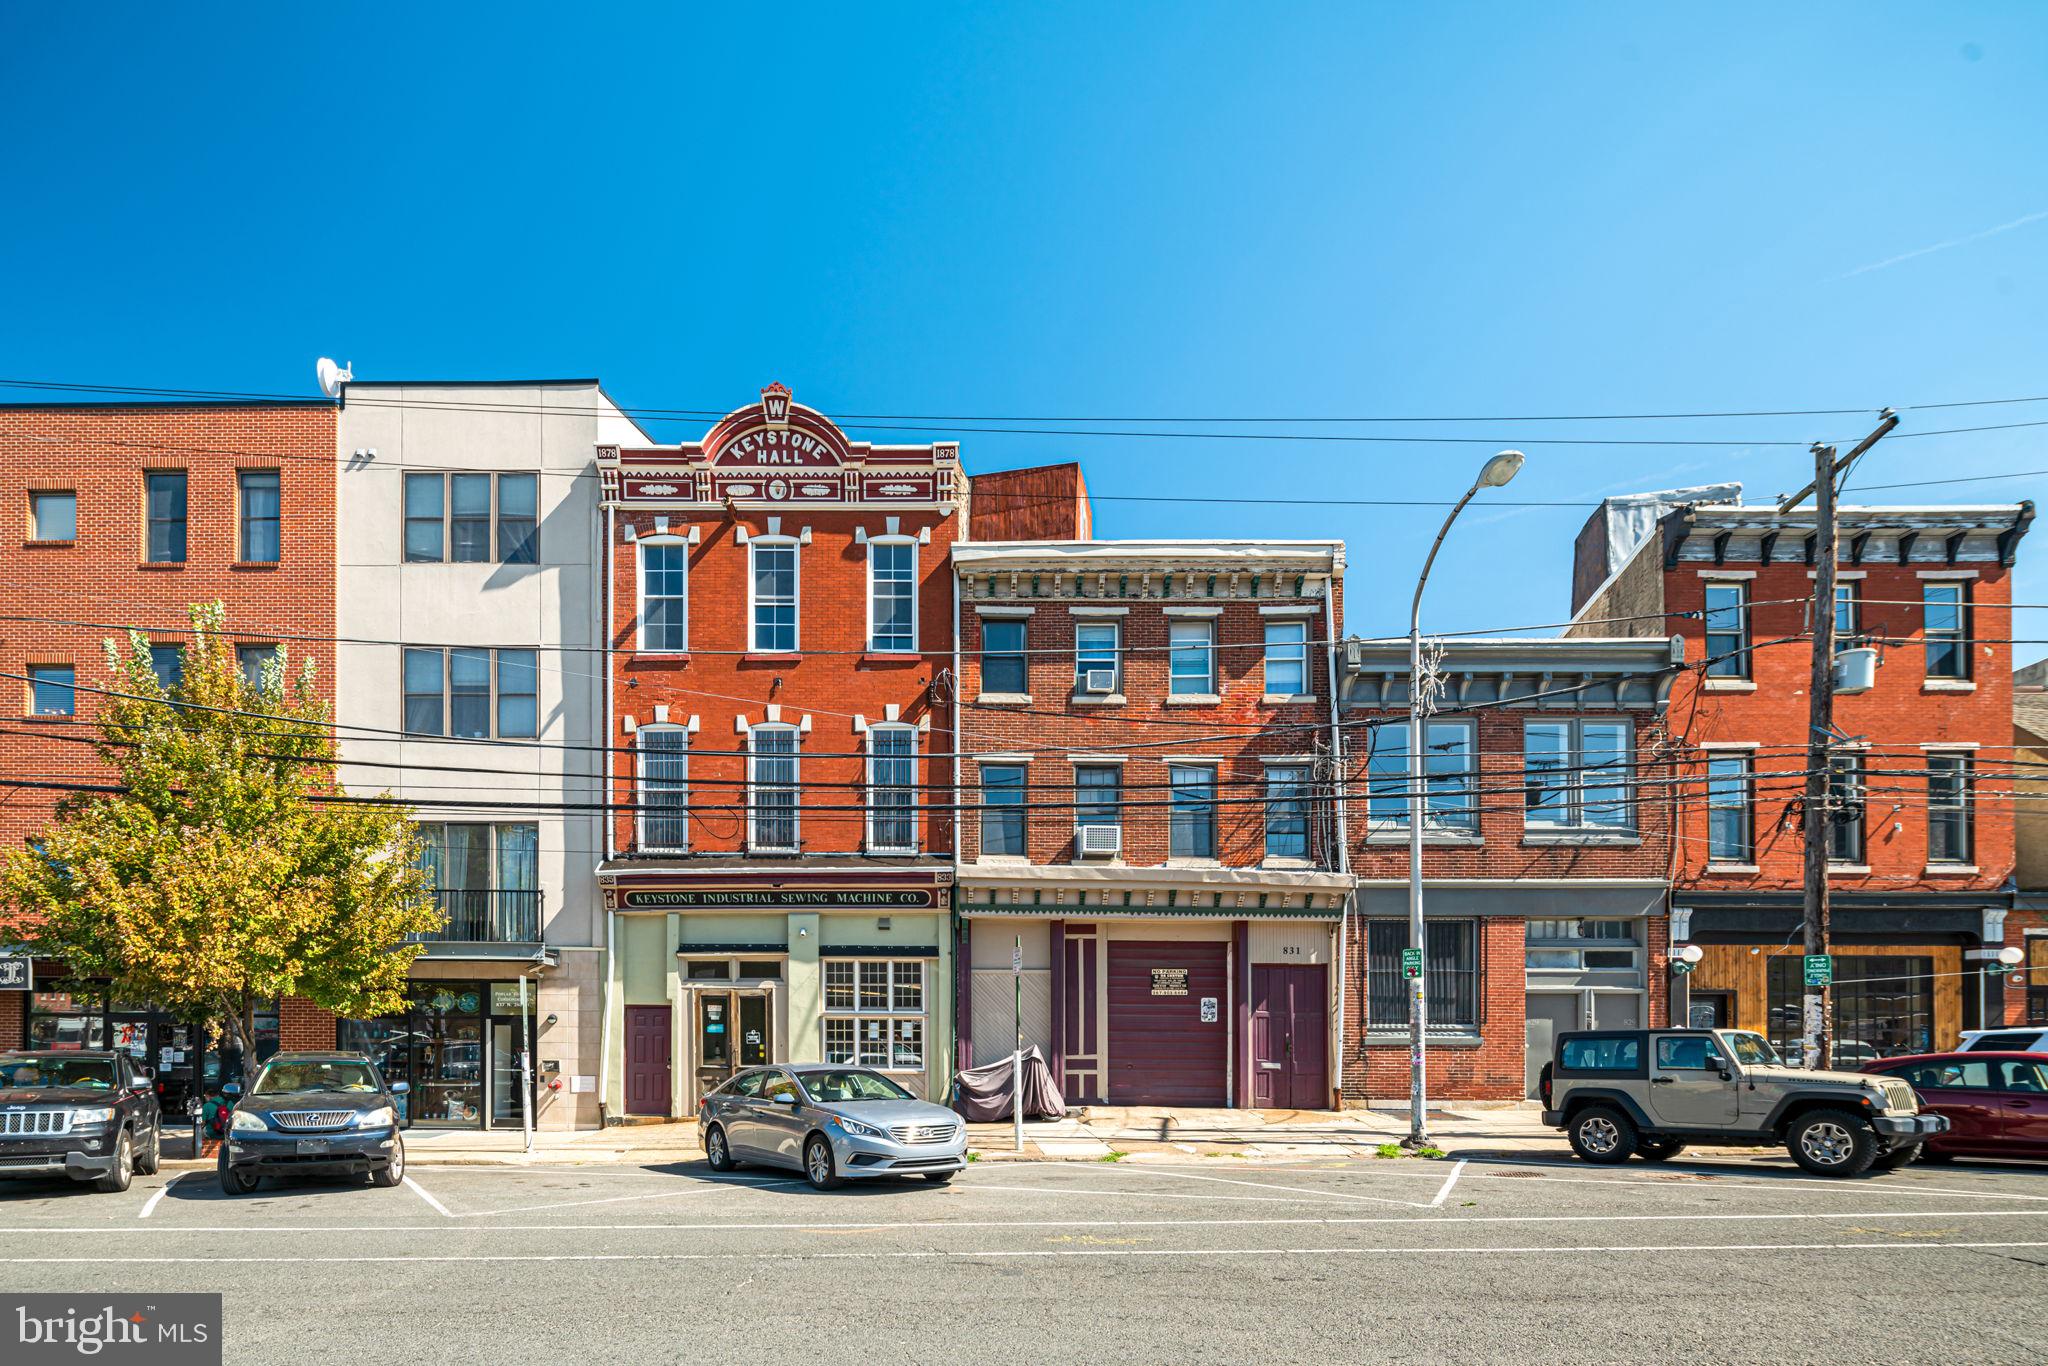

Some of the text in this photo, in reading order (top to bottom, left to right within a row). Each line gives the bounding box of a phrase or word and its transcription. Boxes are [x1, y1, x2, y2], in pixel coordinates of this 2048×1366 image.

[768, 399, 785, 417] W
[729, 430, 828, 460] KEYSTONE
[598, 448, 616, 458] 1878
[757, 449, 804, 464] HALL
[936, 448, 955, 458] 1878
[599, 875, 614, 884] 835
[937, 872, 952, 881] 833
[635, 893, 920, 904] KEYSTONE INDUSTRIAL SEWING MACHINE CO.
[1282, 946, 1300, 955] 831
